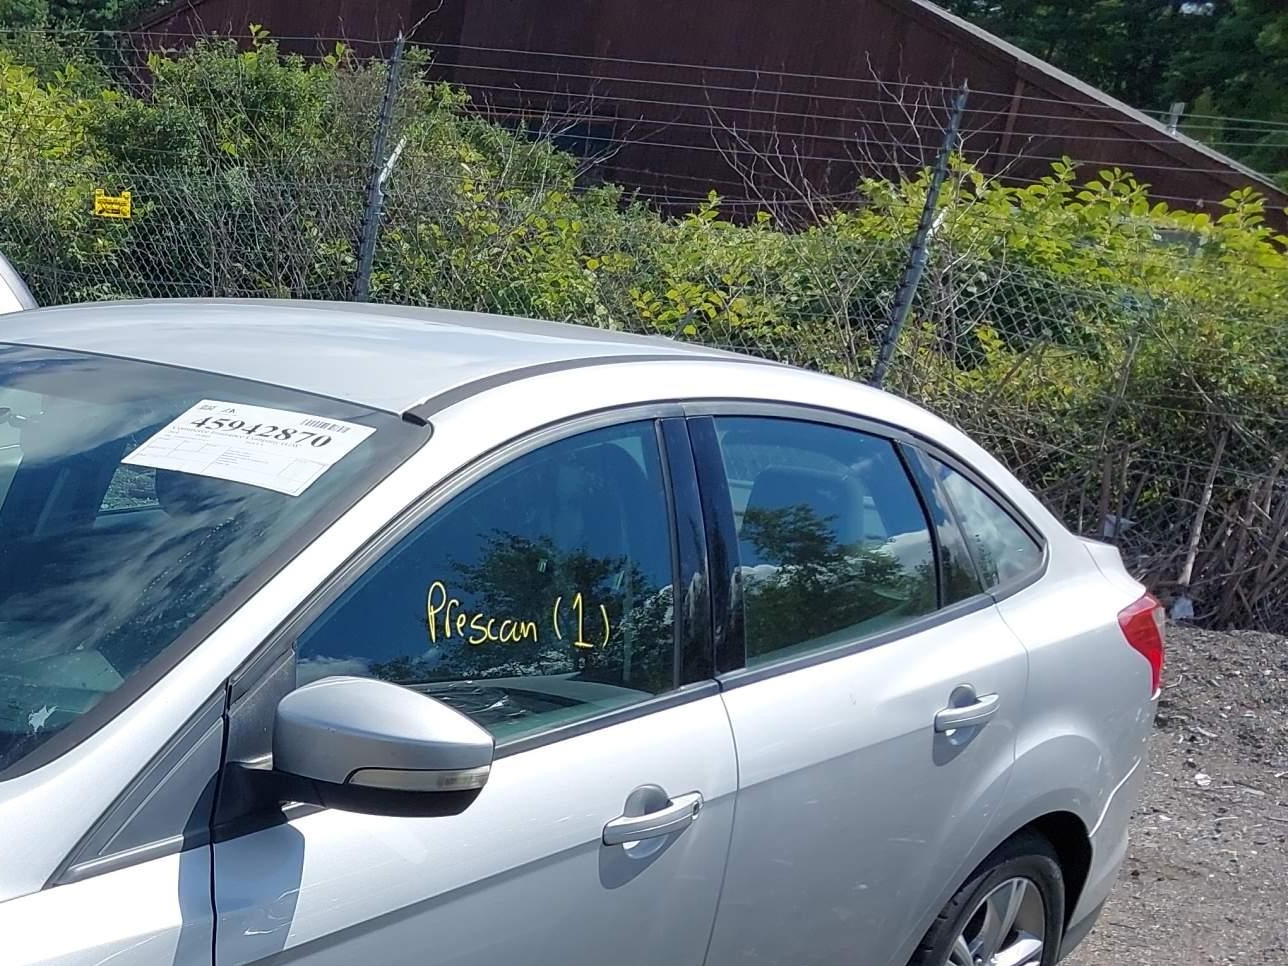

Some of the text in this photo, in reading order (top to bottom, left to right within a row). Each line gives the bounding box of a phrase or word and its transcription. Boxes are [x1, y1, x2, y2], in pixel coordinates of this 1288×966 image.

[191, 416, 333, 449] 45942870
[427, 581, 610, 648] Prescan (1)
